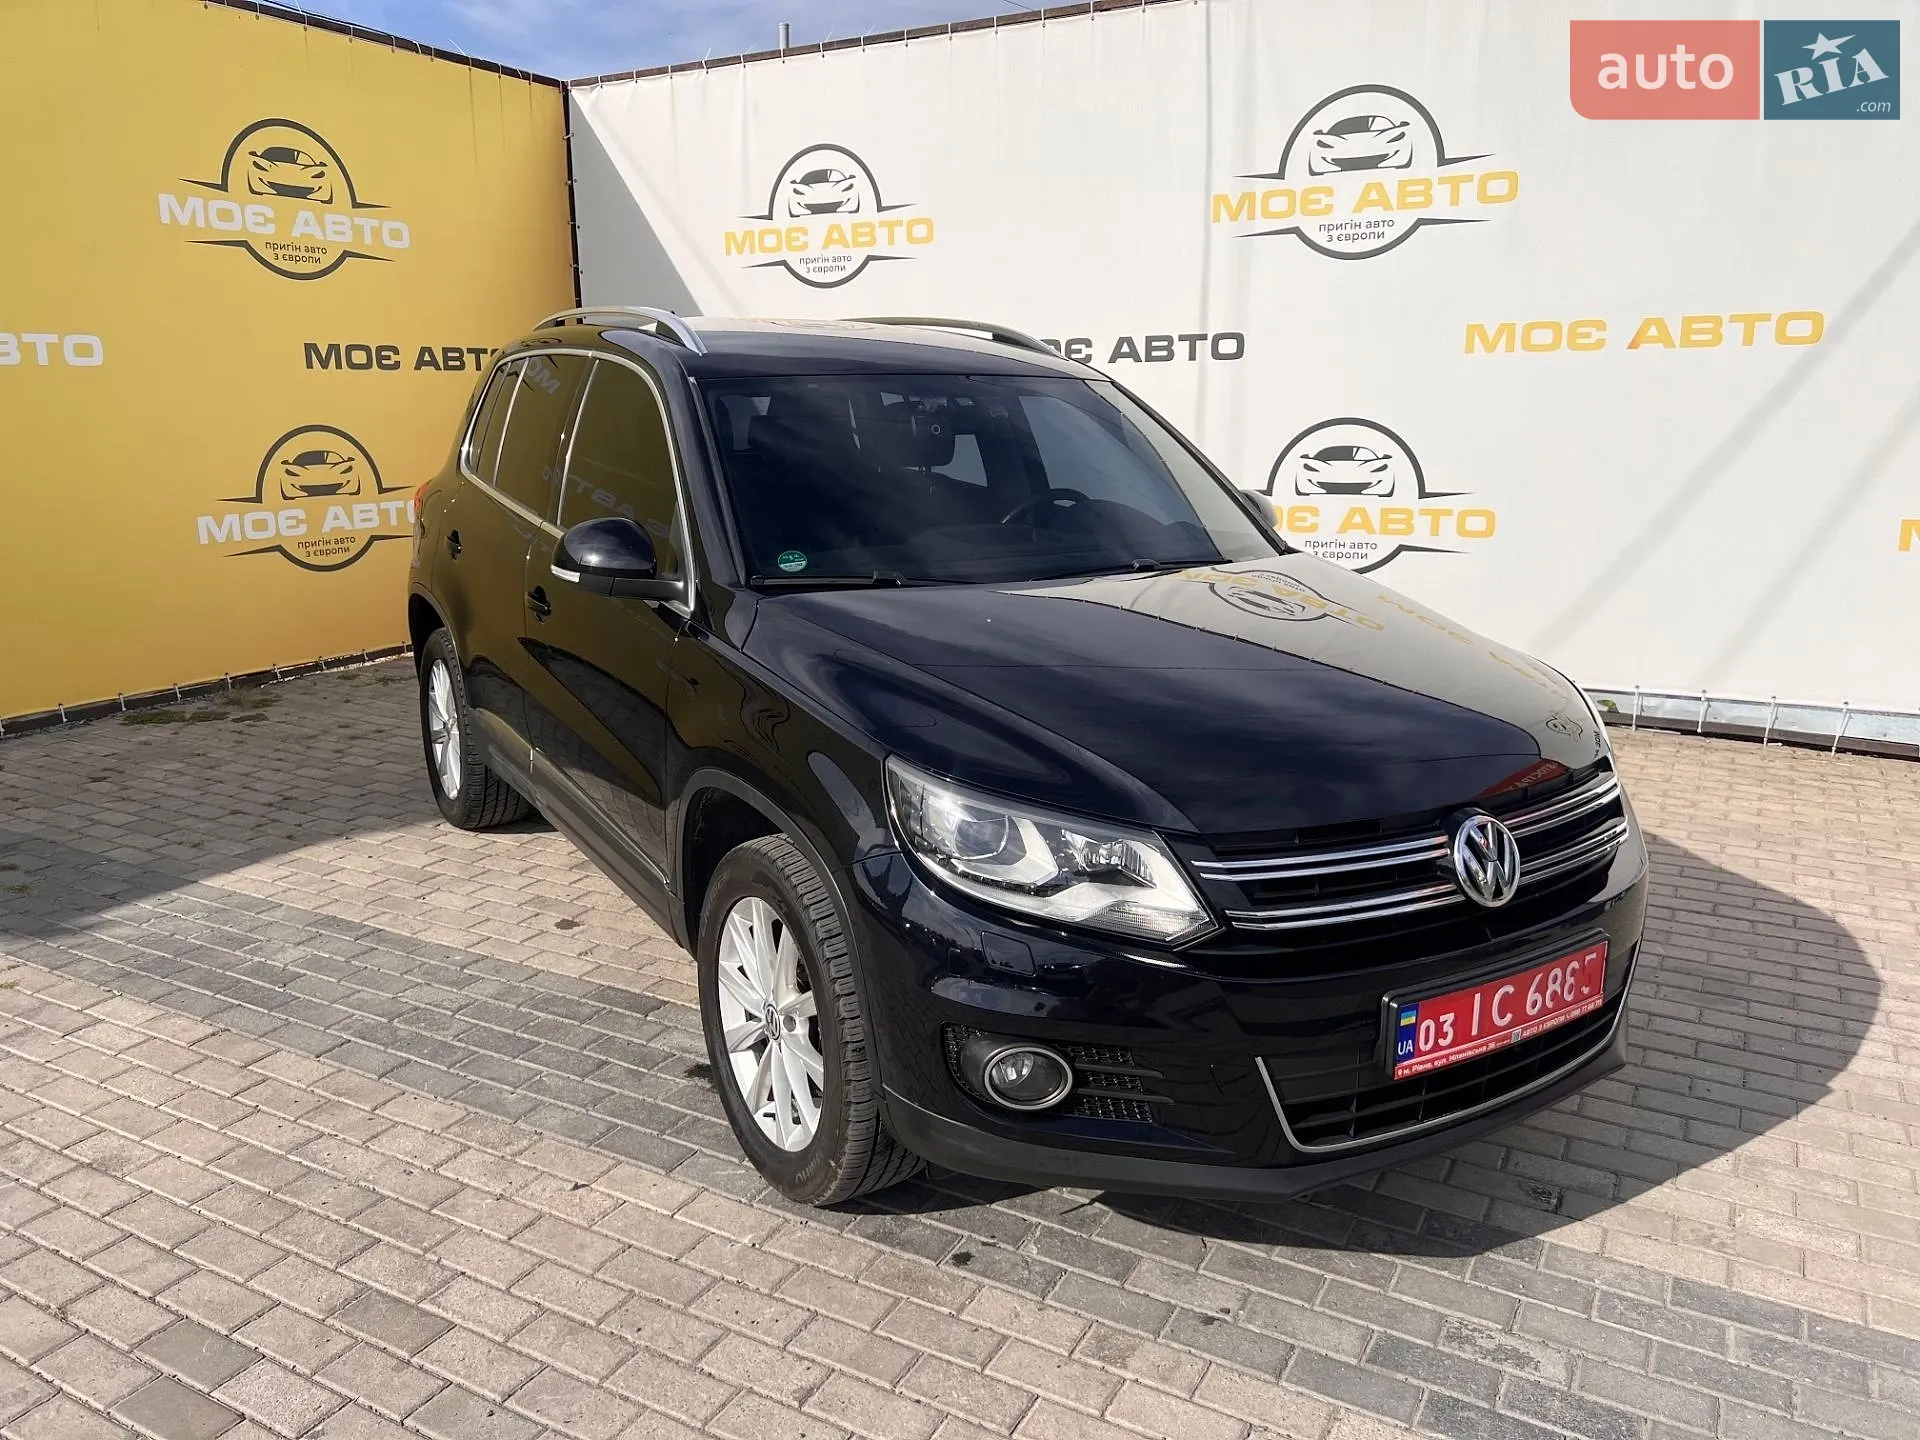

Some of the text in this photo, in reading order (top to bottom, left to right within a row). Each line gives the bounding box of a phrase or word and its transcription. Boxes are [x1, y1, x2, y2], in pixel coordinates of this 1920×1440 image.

[1211, 170, 1520, 225] МОЄ АВТО
[157, 192, 410, 249] МОЄ АВТО
[1318, 218, 1395, 235] пригін авто
[724, 217, 934, 257] МОЄ АВТО
[1327, 231, 1385, 244] з європи
[264, 240, 328, 255] пригін авто
[273, 251, 321, 265] з європи
[799, 254, 852, 266] пригін авто
[813, 263, 846, 274] європи
[1464, 311, 1825, 355] МОЄ АВТО
[0, 332, 104, 367] ВТО
[1107, 332, 1245, 364] АВТО
[304, 343, 500, 372] МОЄ АВТ
[197, 500, 415, 545] МОЄ АВТ
[1336, 505, 1496, 539] АВТО
[297, 535, 356, 551] пригін авто
[1304, 539, 1377, 551] пригін авто
[305, 545, 350, 559] з європи
[1322, 550, 1368, 561] європи
[1419, 1012, 1455, 1052] 03
[1398, 1040, 1414, 1055] UA
